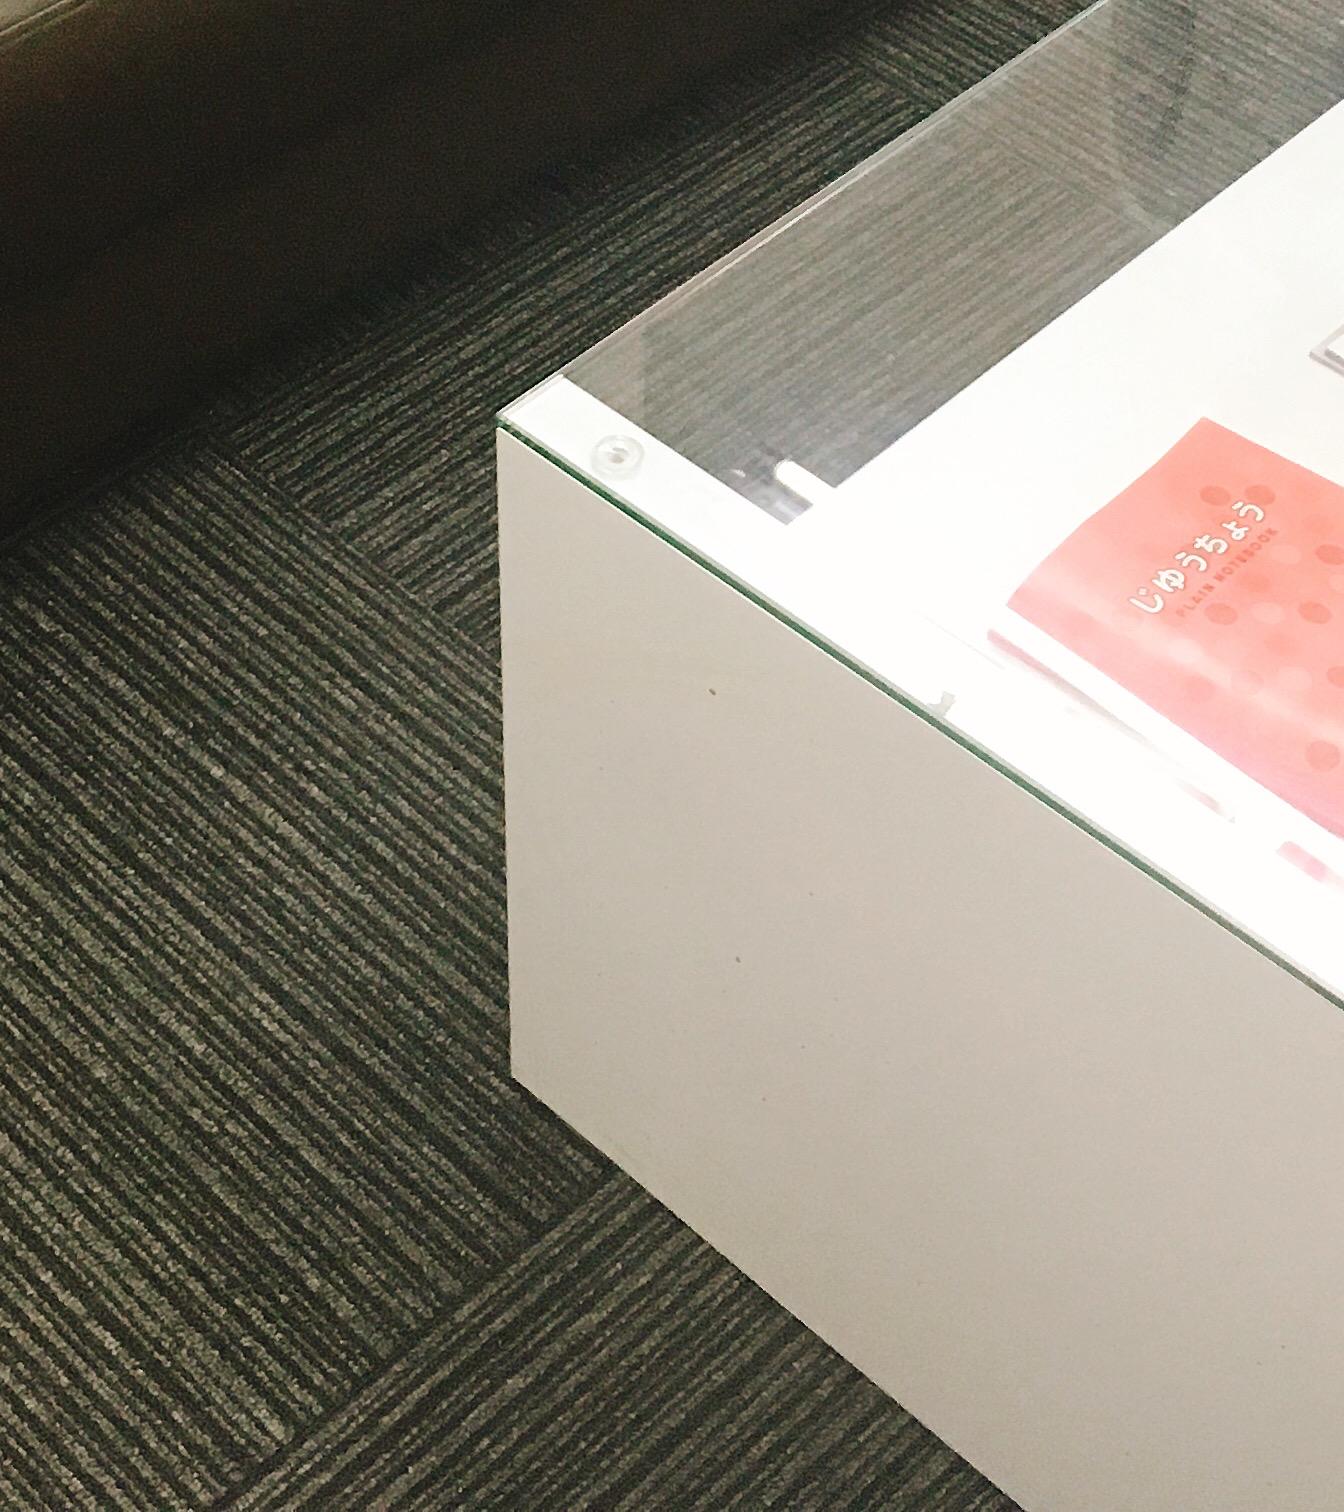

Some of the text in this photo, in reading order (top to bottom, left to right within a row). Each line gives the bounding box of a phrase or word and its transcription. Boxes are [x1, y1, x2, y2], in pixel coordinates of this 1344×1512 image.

[1129, 501, 1265, 613] じゆうちょう
[1176, 527, 1279, 617] PLAIN NOTEBOOK
